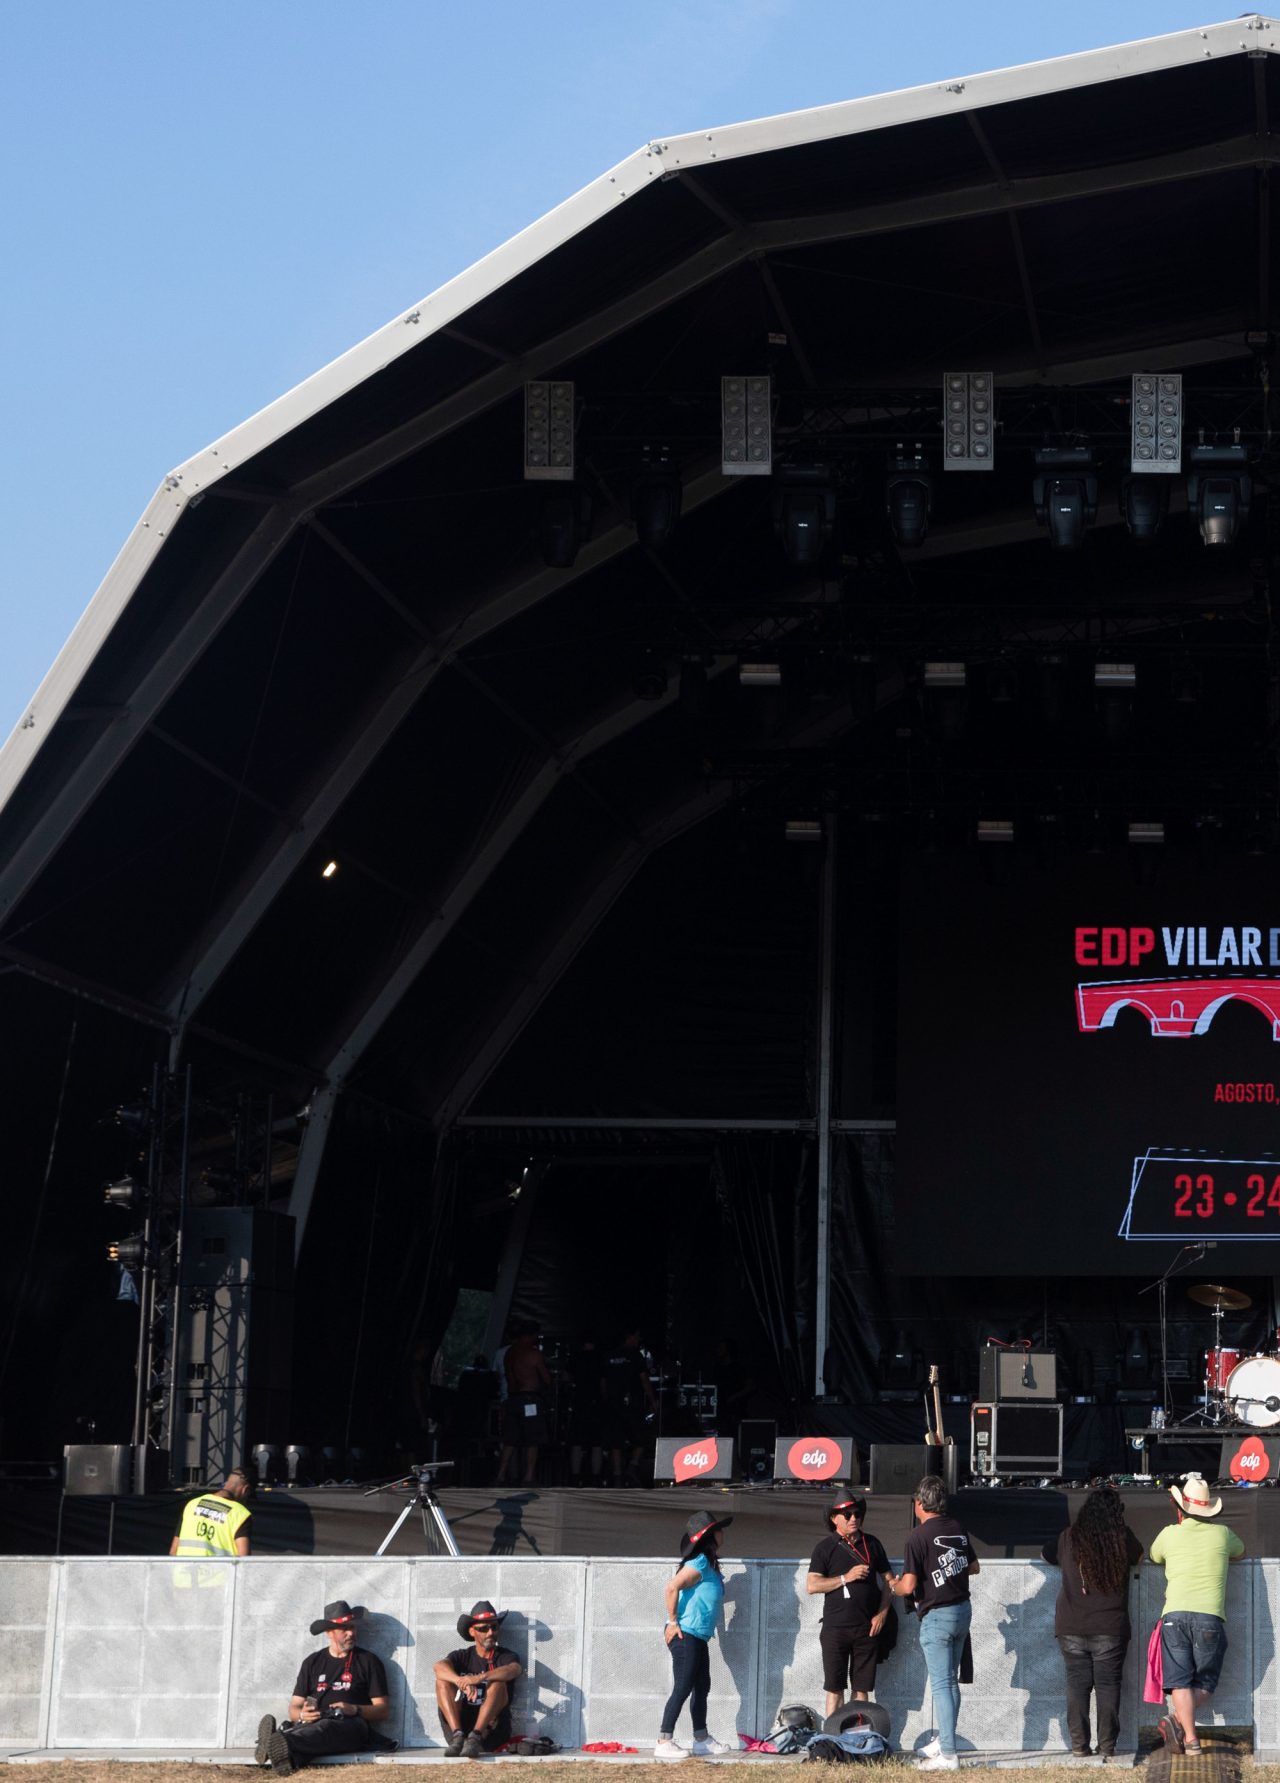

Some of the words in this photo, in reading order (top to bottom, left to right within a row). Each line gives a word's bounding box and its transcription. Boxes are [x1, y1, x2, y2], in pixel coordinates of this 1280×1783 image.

[1075, 927, 1155, 966] EDP
[1162, 927, 1263, 966] VILAR
[1214, 1083, 1280, 1105] AGOSTO,
[1174, 1174, 1214, 1217] 23
[683, 1450, 709, 1468] edp
[801, 1449, 827, 1468] edp
[1240, 1452, 1261, 1471] edp
